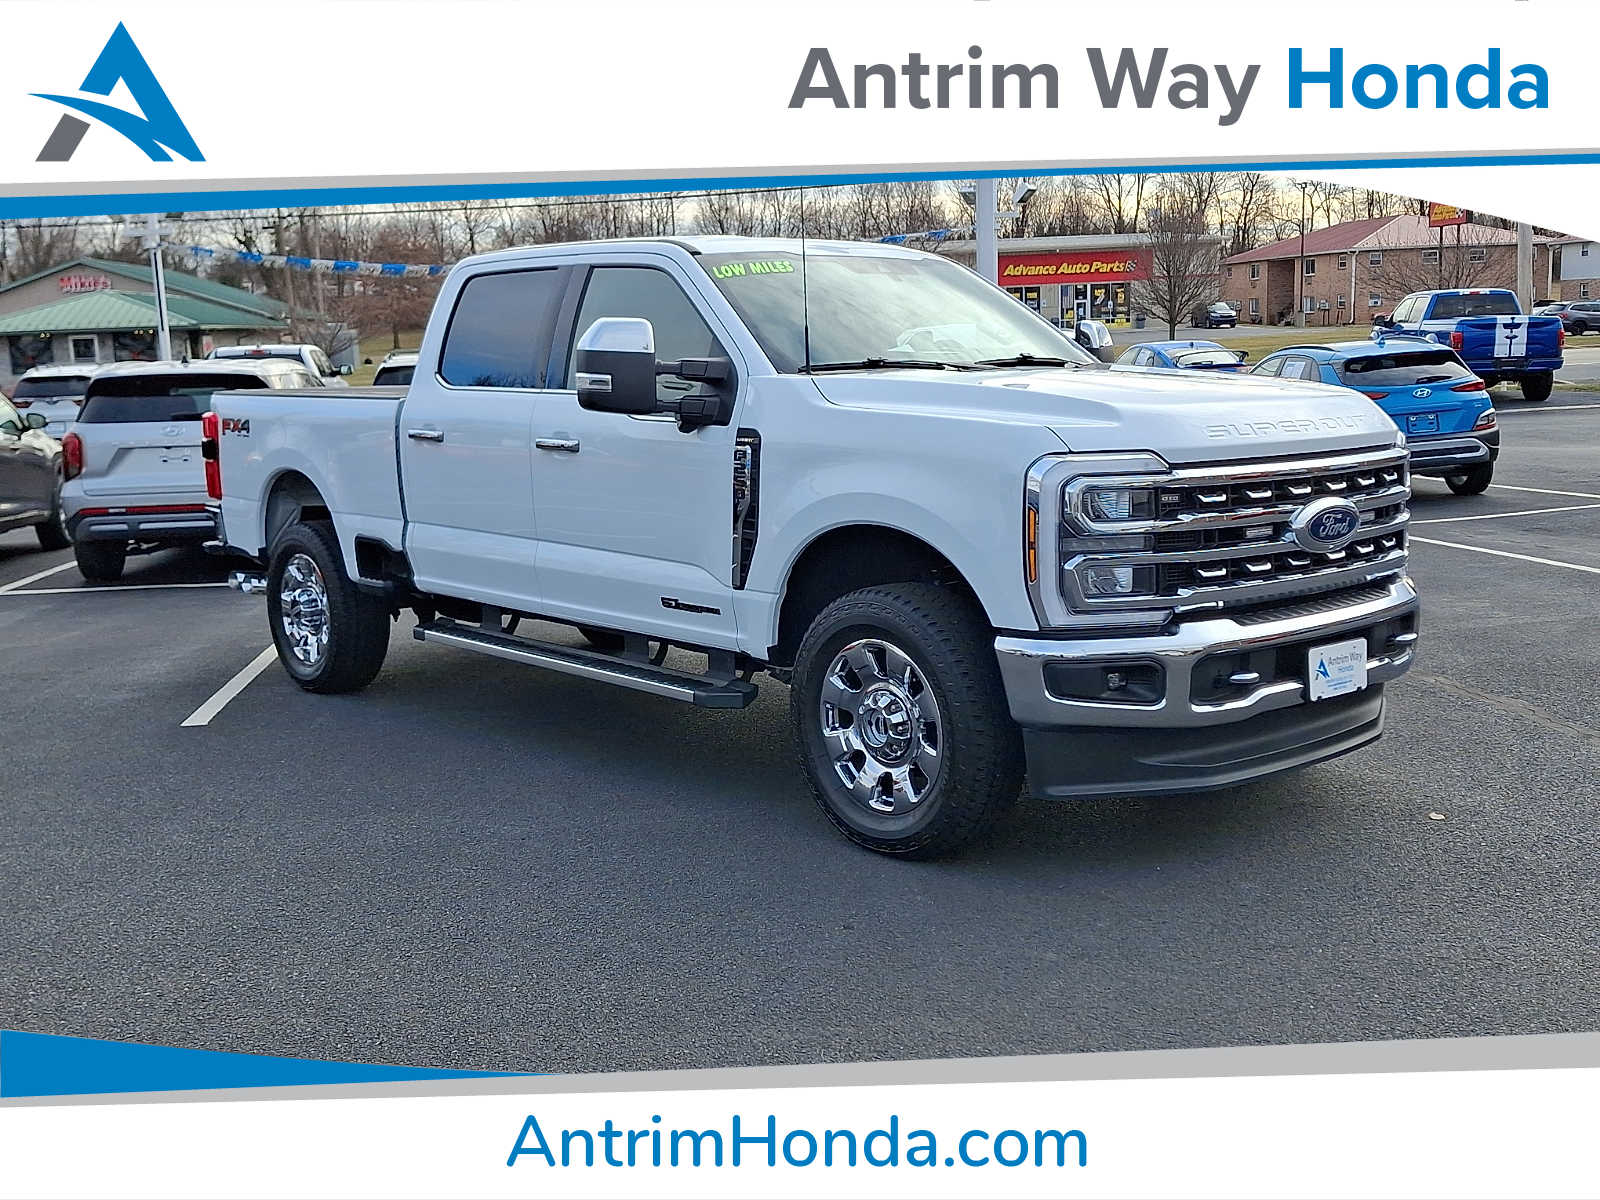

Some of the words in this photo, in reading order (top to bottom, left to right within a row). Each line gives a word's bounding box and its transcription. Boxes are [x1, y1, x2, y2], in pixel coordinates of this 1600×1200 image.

[712, 263, 747, 279] LOW
[749, 260, 795, 274] MILES
[1003, 264, 1057, 276] Advance
[1057, 262, 1091, 274] Auto
[1091, 260, 1125, 273] Parts
[222, 418, 250, 435] FX4
[1206, 419, 1319, 438] SUPER
[1319, 513, 1351, 537] Ford
